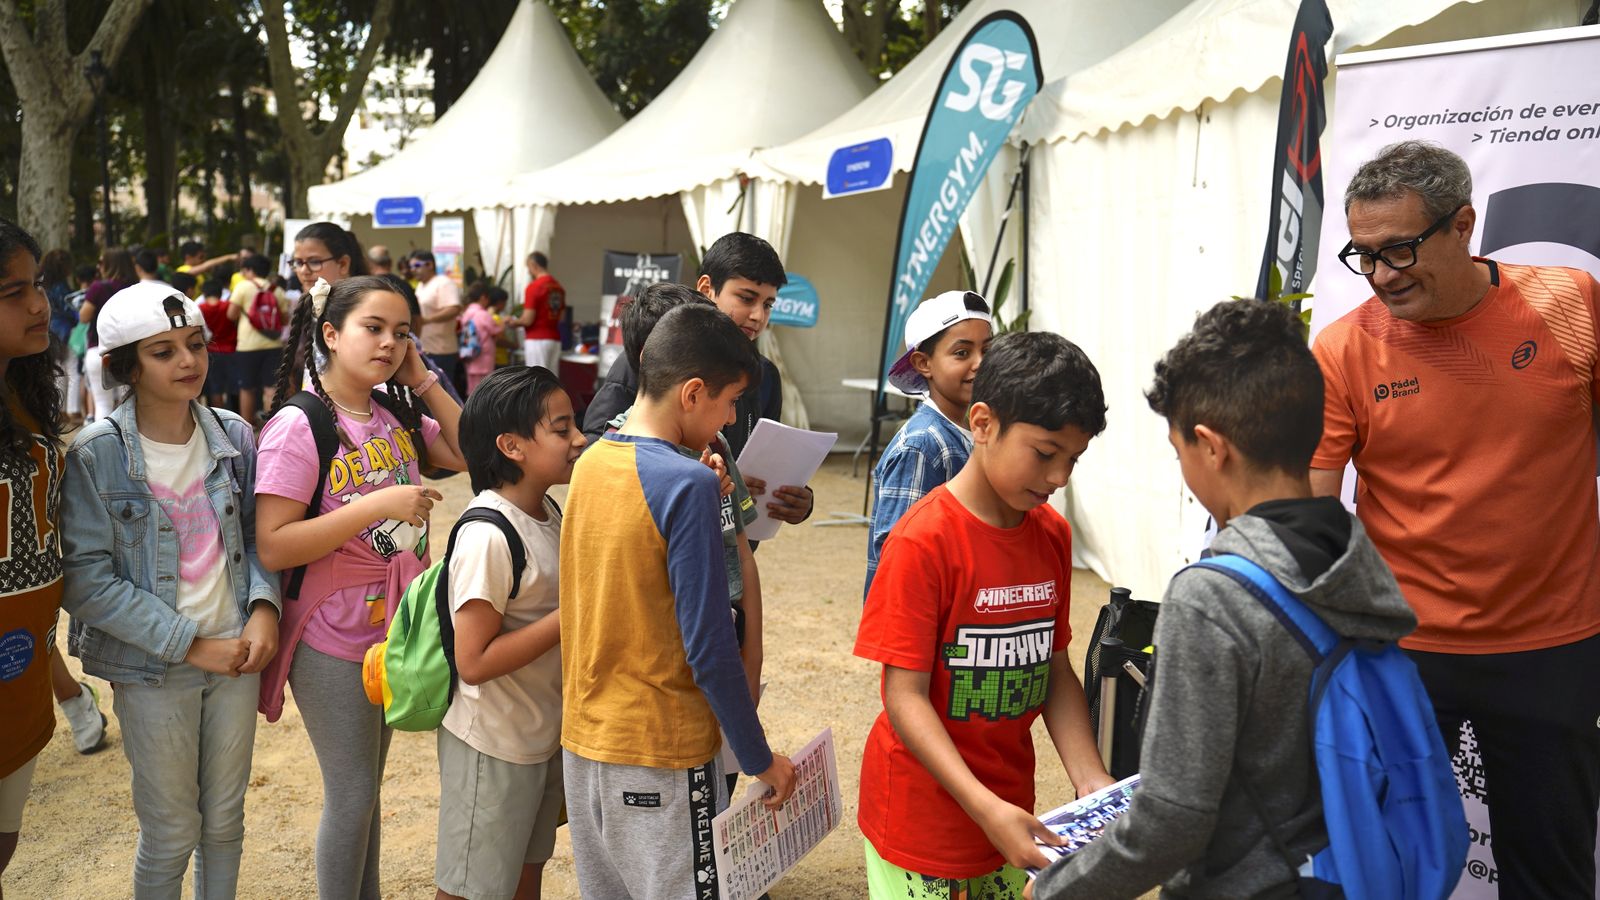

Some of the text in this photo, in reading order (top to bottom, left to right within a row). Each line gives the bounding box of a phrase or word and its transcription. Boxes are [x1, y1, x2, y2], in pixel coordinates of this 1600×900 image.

[943, 42, 1028, 121] SG
[1383, 106, 1513, 130] Organización
[1519, 103, 1547, 119] de
[1489, 126, 1560, 144] Tienda
[895, 130, 985, 315] SYNERGYM
[1391, 377, 1419, 390] Pádel
[1392, 386, 1420, 399] Brand
[948, 620, 1056, 668] SURVIV
[696, 806, 712, 863] KELME
